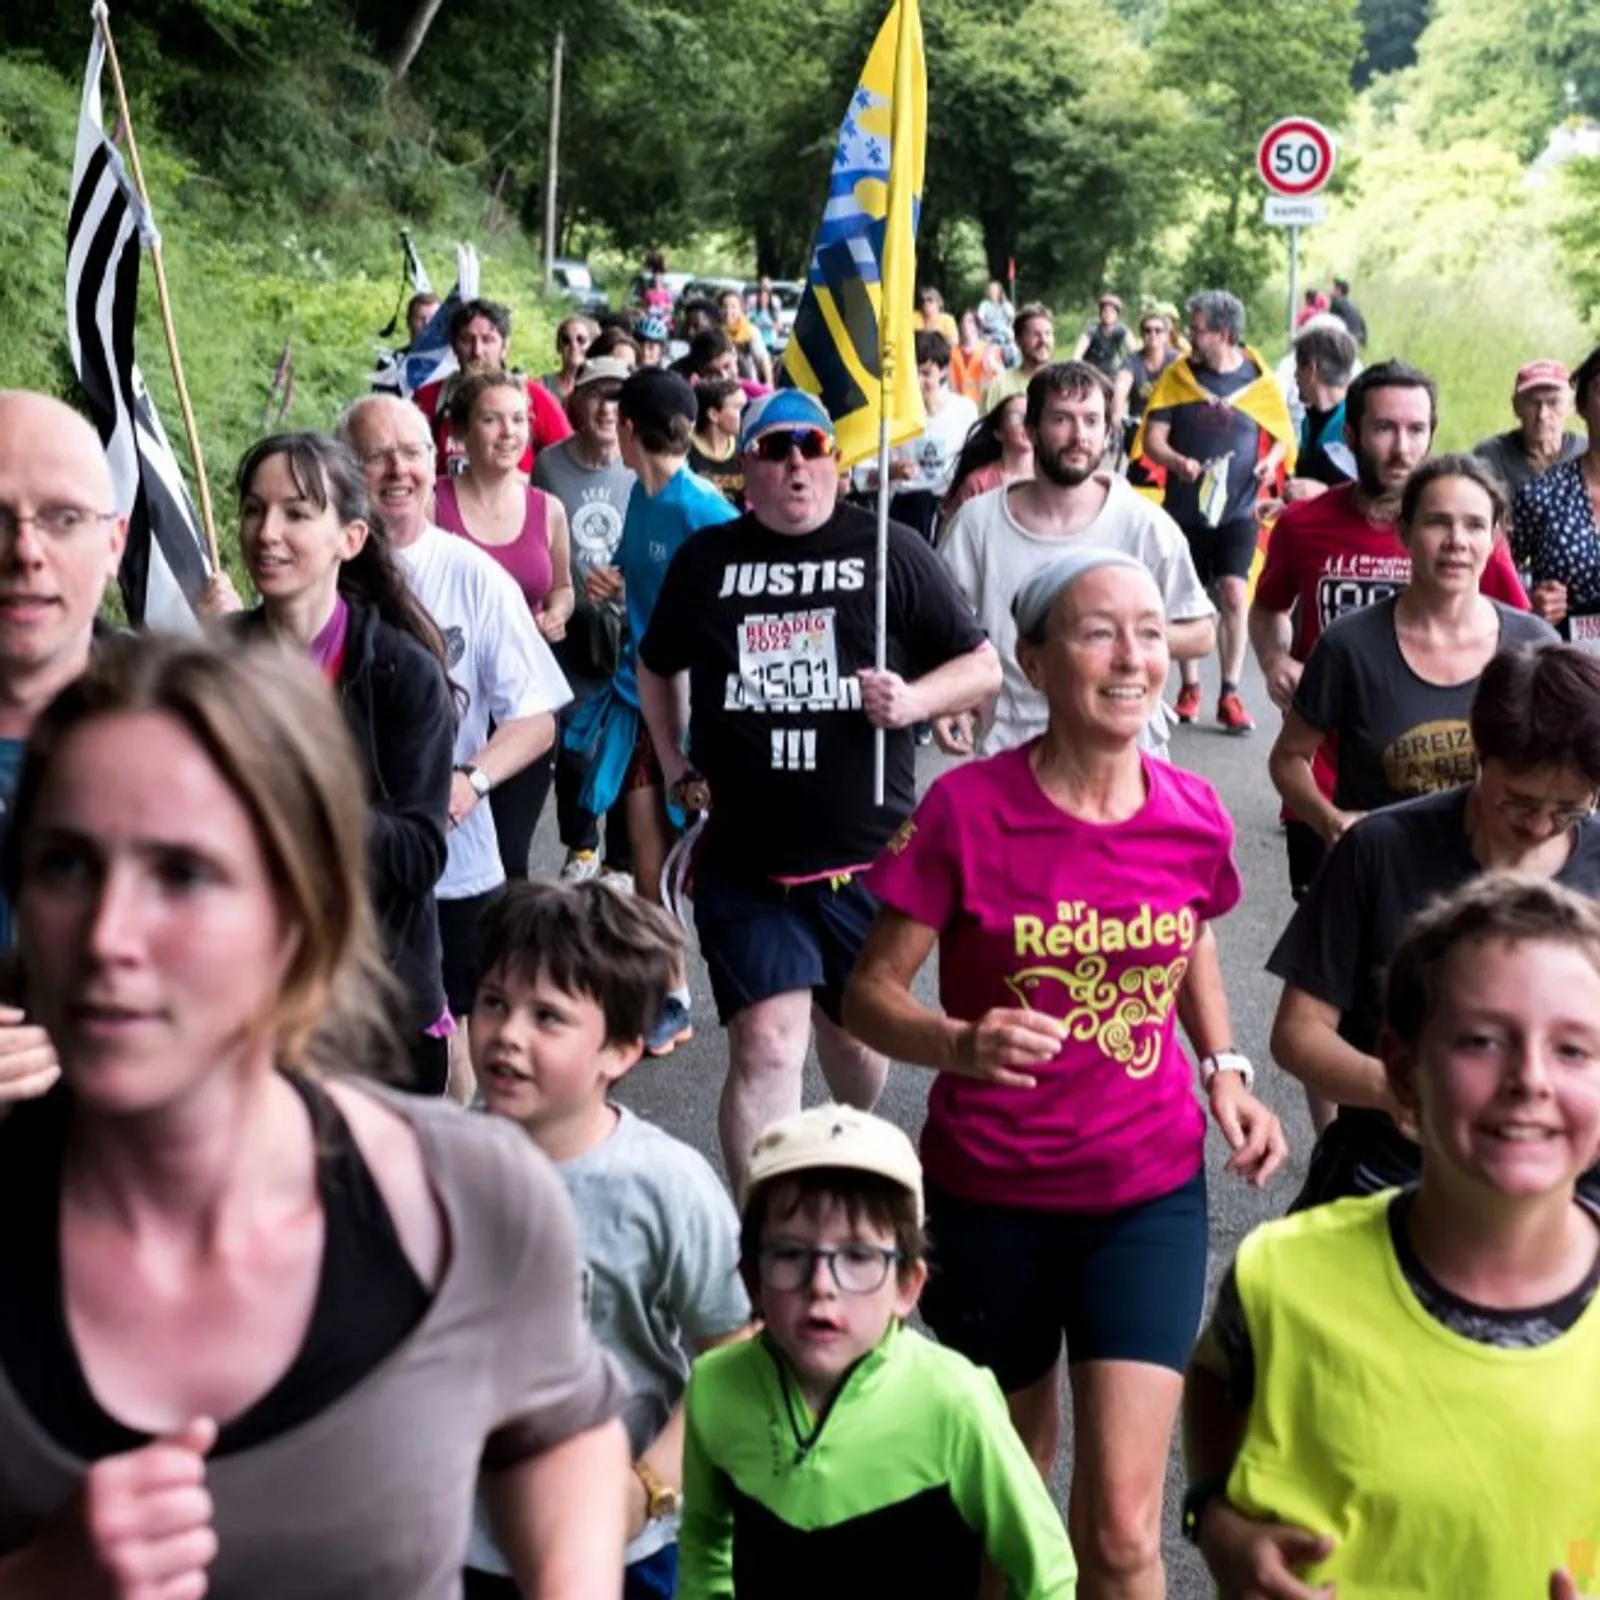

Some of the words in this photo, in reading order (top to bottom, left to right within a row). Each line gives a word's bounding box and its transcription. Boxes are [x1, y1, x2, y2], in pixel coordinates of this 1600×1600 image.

[1275, 143, 1318, 174] 50
[718, 557, 865, 598] JUSTIS
[746, 616, 826, 639] REDADEG
[747, 635, 791, 653] 2022
[751, 657, 830, 699] 1501
[771, 729, 817, 770] !!!
[1057, 900, 1087, 921] ar
[1013, 903, 1195, 957] Redadeg
